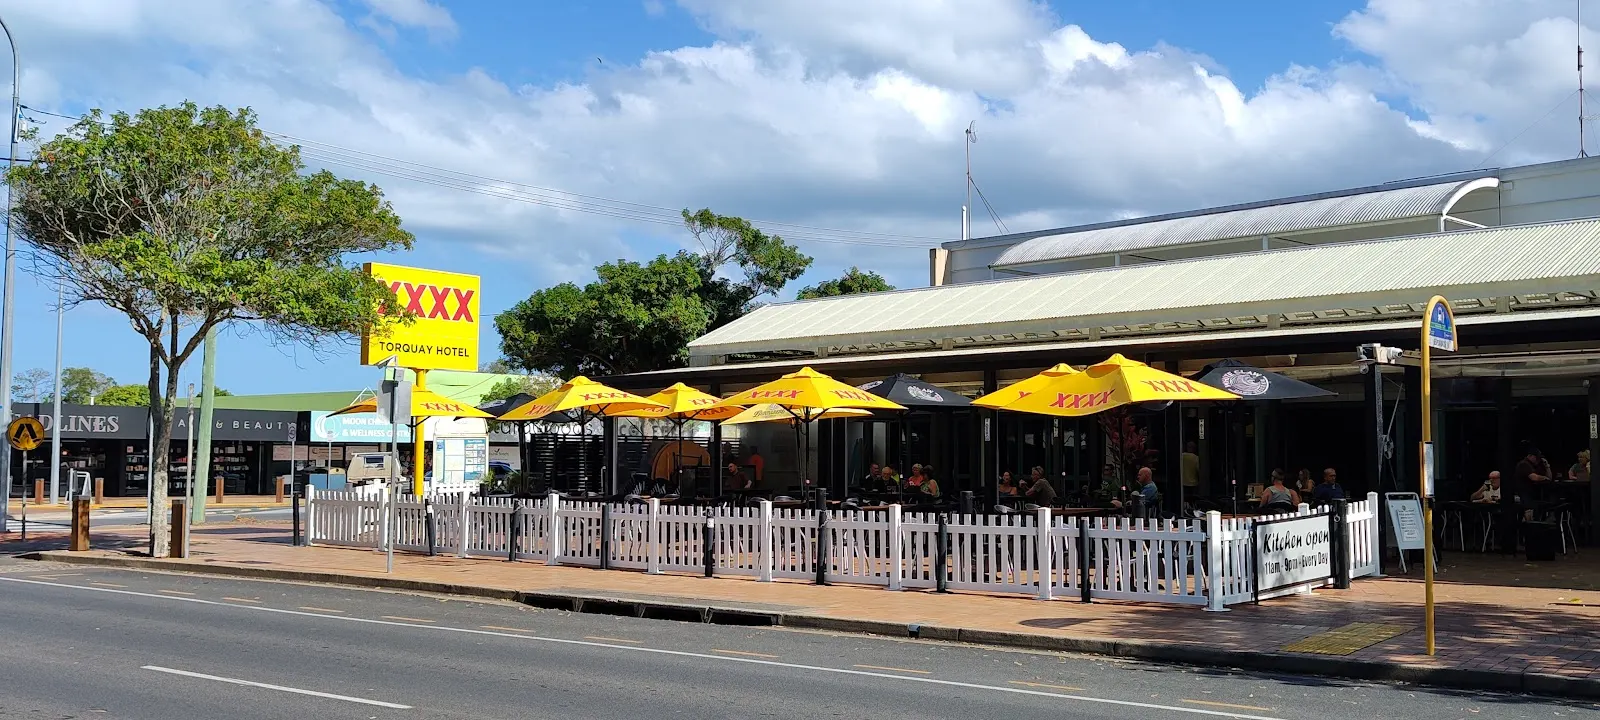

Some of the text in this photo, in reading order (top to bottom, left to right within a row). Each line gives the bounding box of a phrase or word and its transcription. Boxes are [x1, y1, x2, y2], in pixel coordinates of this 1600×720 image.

[379, 341, 470, 358] TORQUAY HOTEL
[1140, 380, 1200, 394] XXXX
[744, 390, 804, 399] XXXX
[829, 390, 877, 402] XXXX
[1050, 389, 1116, 409] XXXX
[420, 402, 466, 412] XXXX
[13, 413, 119, 432] DLINES
[216, 420, 223, 429] &
[342, 417, 367, 425] MOON
[350, 429, 385, 437] WELLNESS
[1263, 530, 1302, 553] Kitchen
[1265, 561, 1281, 575] 11am
[1284, 557, 1298, 572] 9pm
[1302, 554, 1318, 569] Every
[1318, 551, 1329, 566] Day
